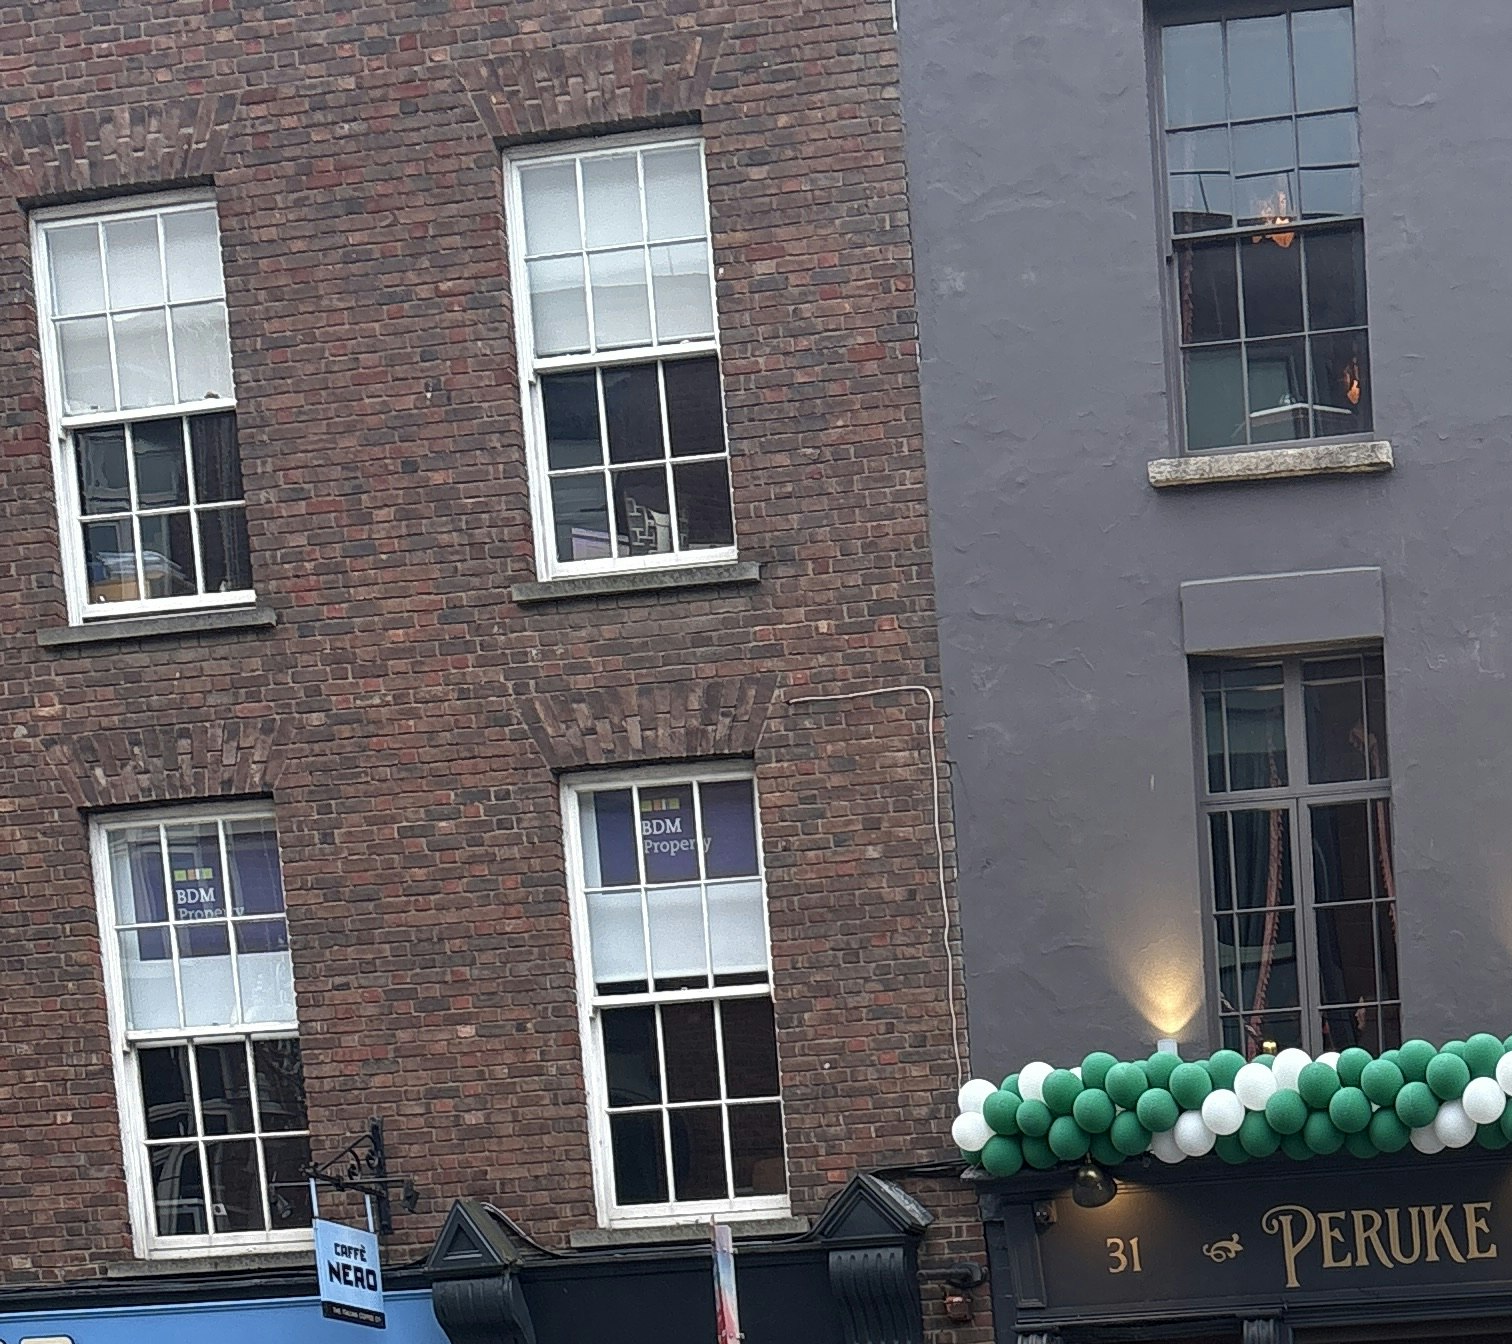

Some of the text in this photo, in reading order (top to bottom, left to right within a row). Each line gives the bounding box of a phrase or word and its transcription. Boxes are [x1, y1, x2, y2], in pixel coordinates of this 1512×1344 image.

[641, 817, 682, 836] BDM
[643, 837, 712, 856] Propery
[175, 887, 216, 904] BDM
[333, 1241, 368, 1263] CAFFÈ
[1106, 1236, 1143, 1274] 31
[1262, 1202, 1498, 1289] PERUKE
[327, 1259, 378, 1292] NERO
